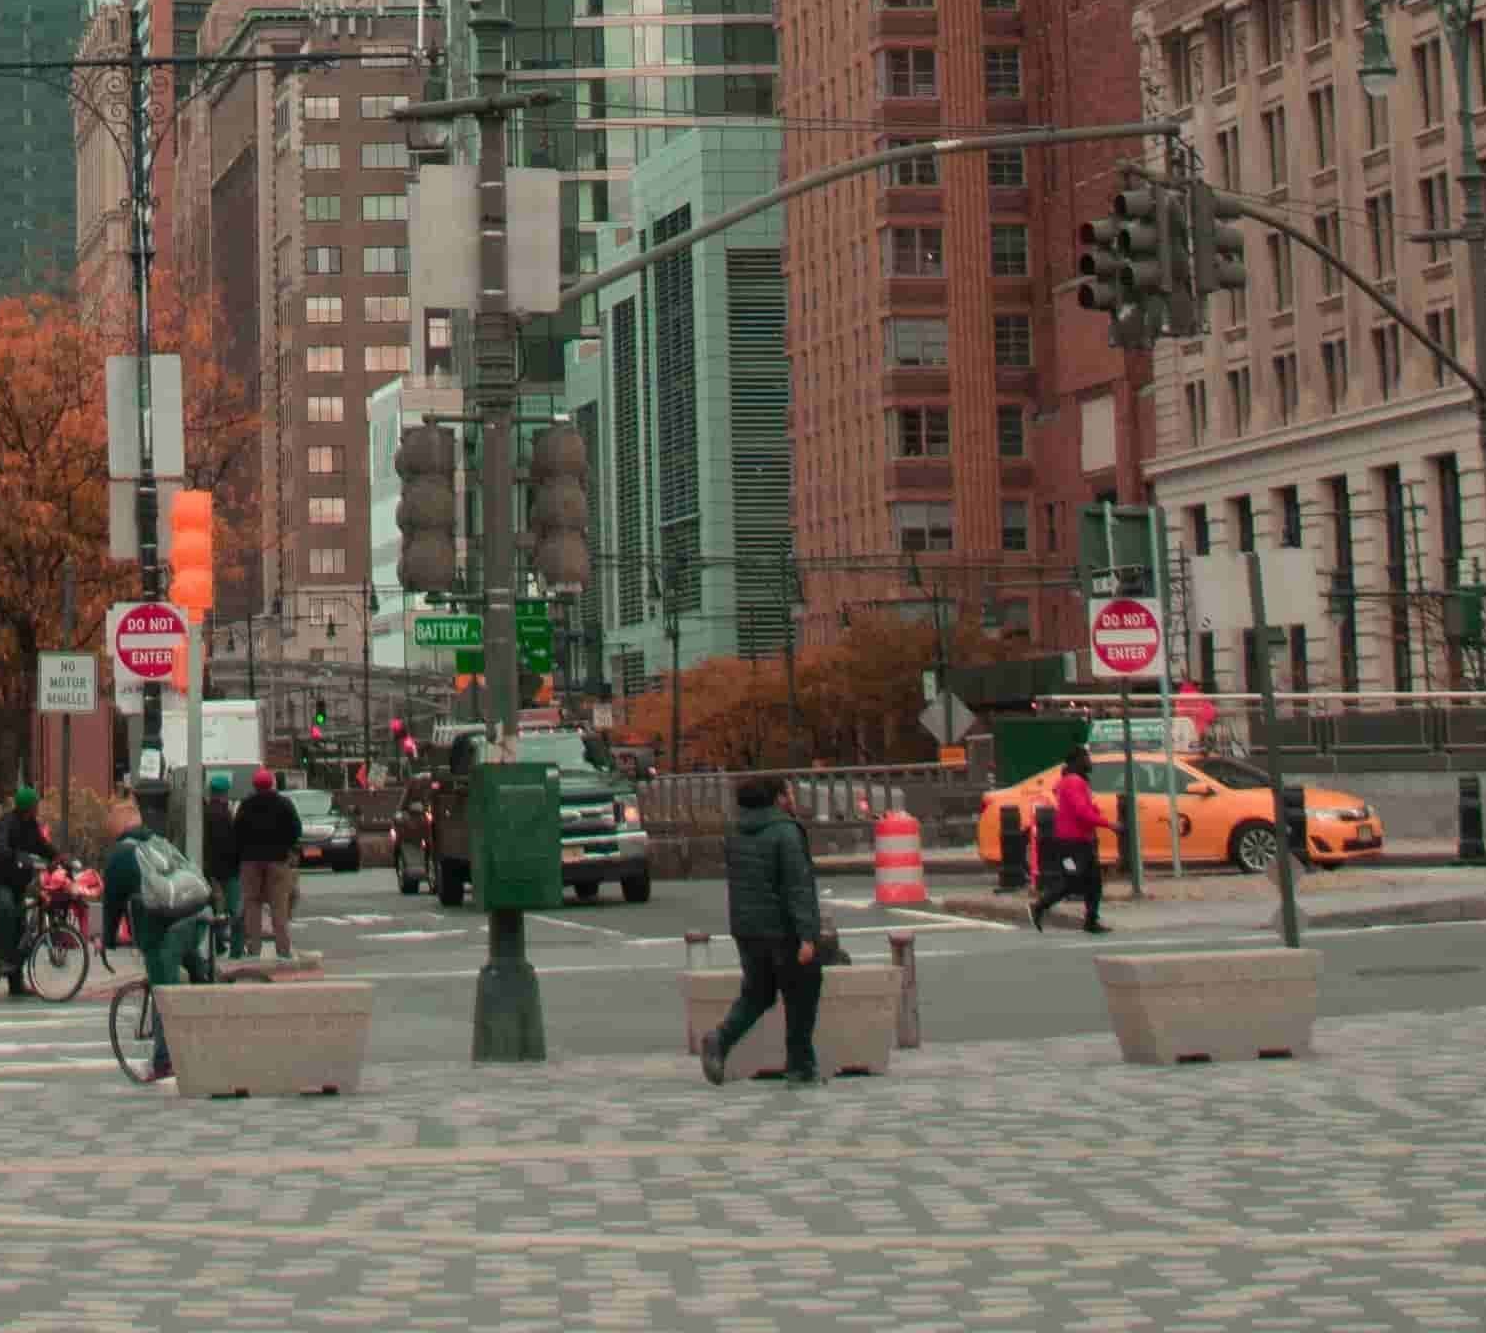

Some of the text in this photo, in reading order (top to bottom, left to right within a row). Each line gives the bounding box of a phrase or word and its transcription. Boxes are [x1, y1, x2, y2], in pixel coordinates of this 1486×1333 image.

[127, 617, 175, 631] DO NOT
[1101, 612, 1147, 627] DO NOT
[416, 621, 469, 641] BATTERY
[131, 651, 173, 664] ENTER
[1107, 646, 1147, 661] ENTER
[60, 660, 76, 671] NO
[49, 676, 87, 688] MOTOR
[47, 692, 88, 704] VEHICLES
